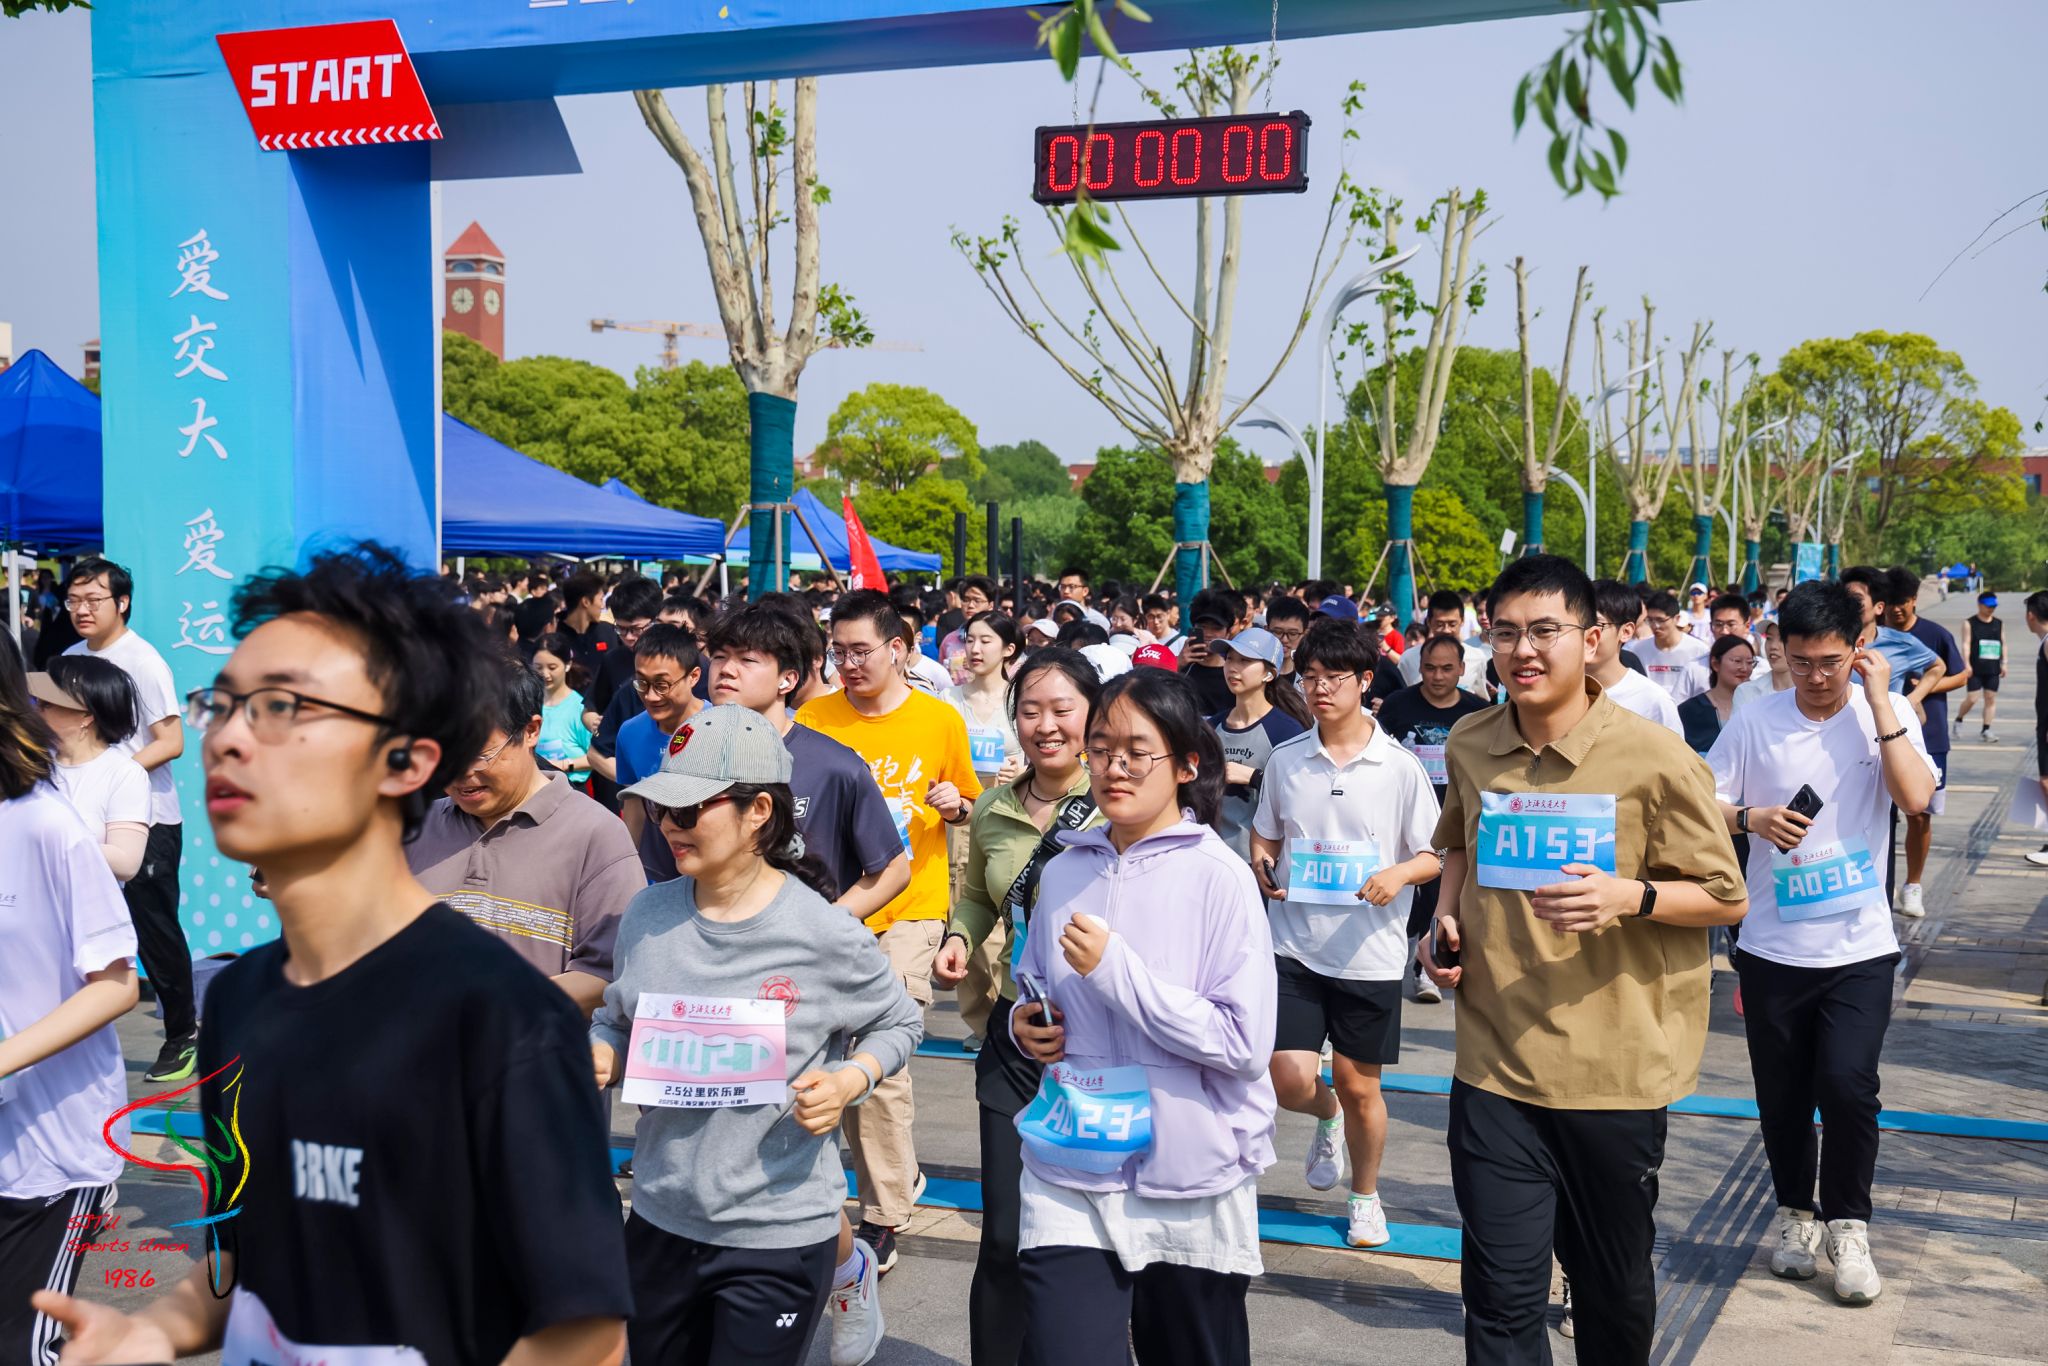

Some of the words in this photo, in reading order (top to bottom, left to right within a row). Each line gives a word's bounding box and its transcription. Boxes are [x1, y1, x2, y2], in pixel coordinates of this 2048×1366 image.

[251, 53, 403, 108] START
[168, 228, 230, 460] 爱交大
[973, 740, 997, 758] 70
[1494, 824, 1597, 861] A153
[1302, 860, 1364, 885] A071
[1788, 861, 1863, 899] A036
[664, 1085, 746, 1099] 2.5公里欢乐跑
